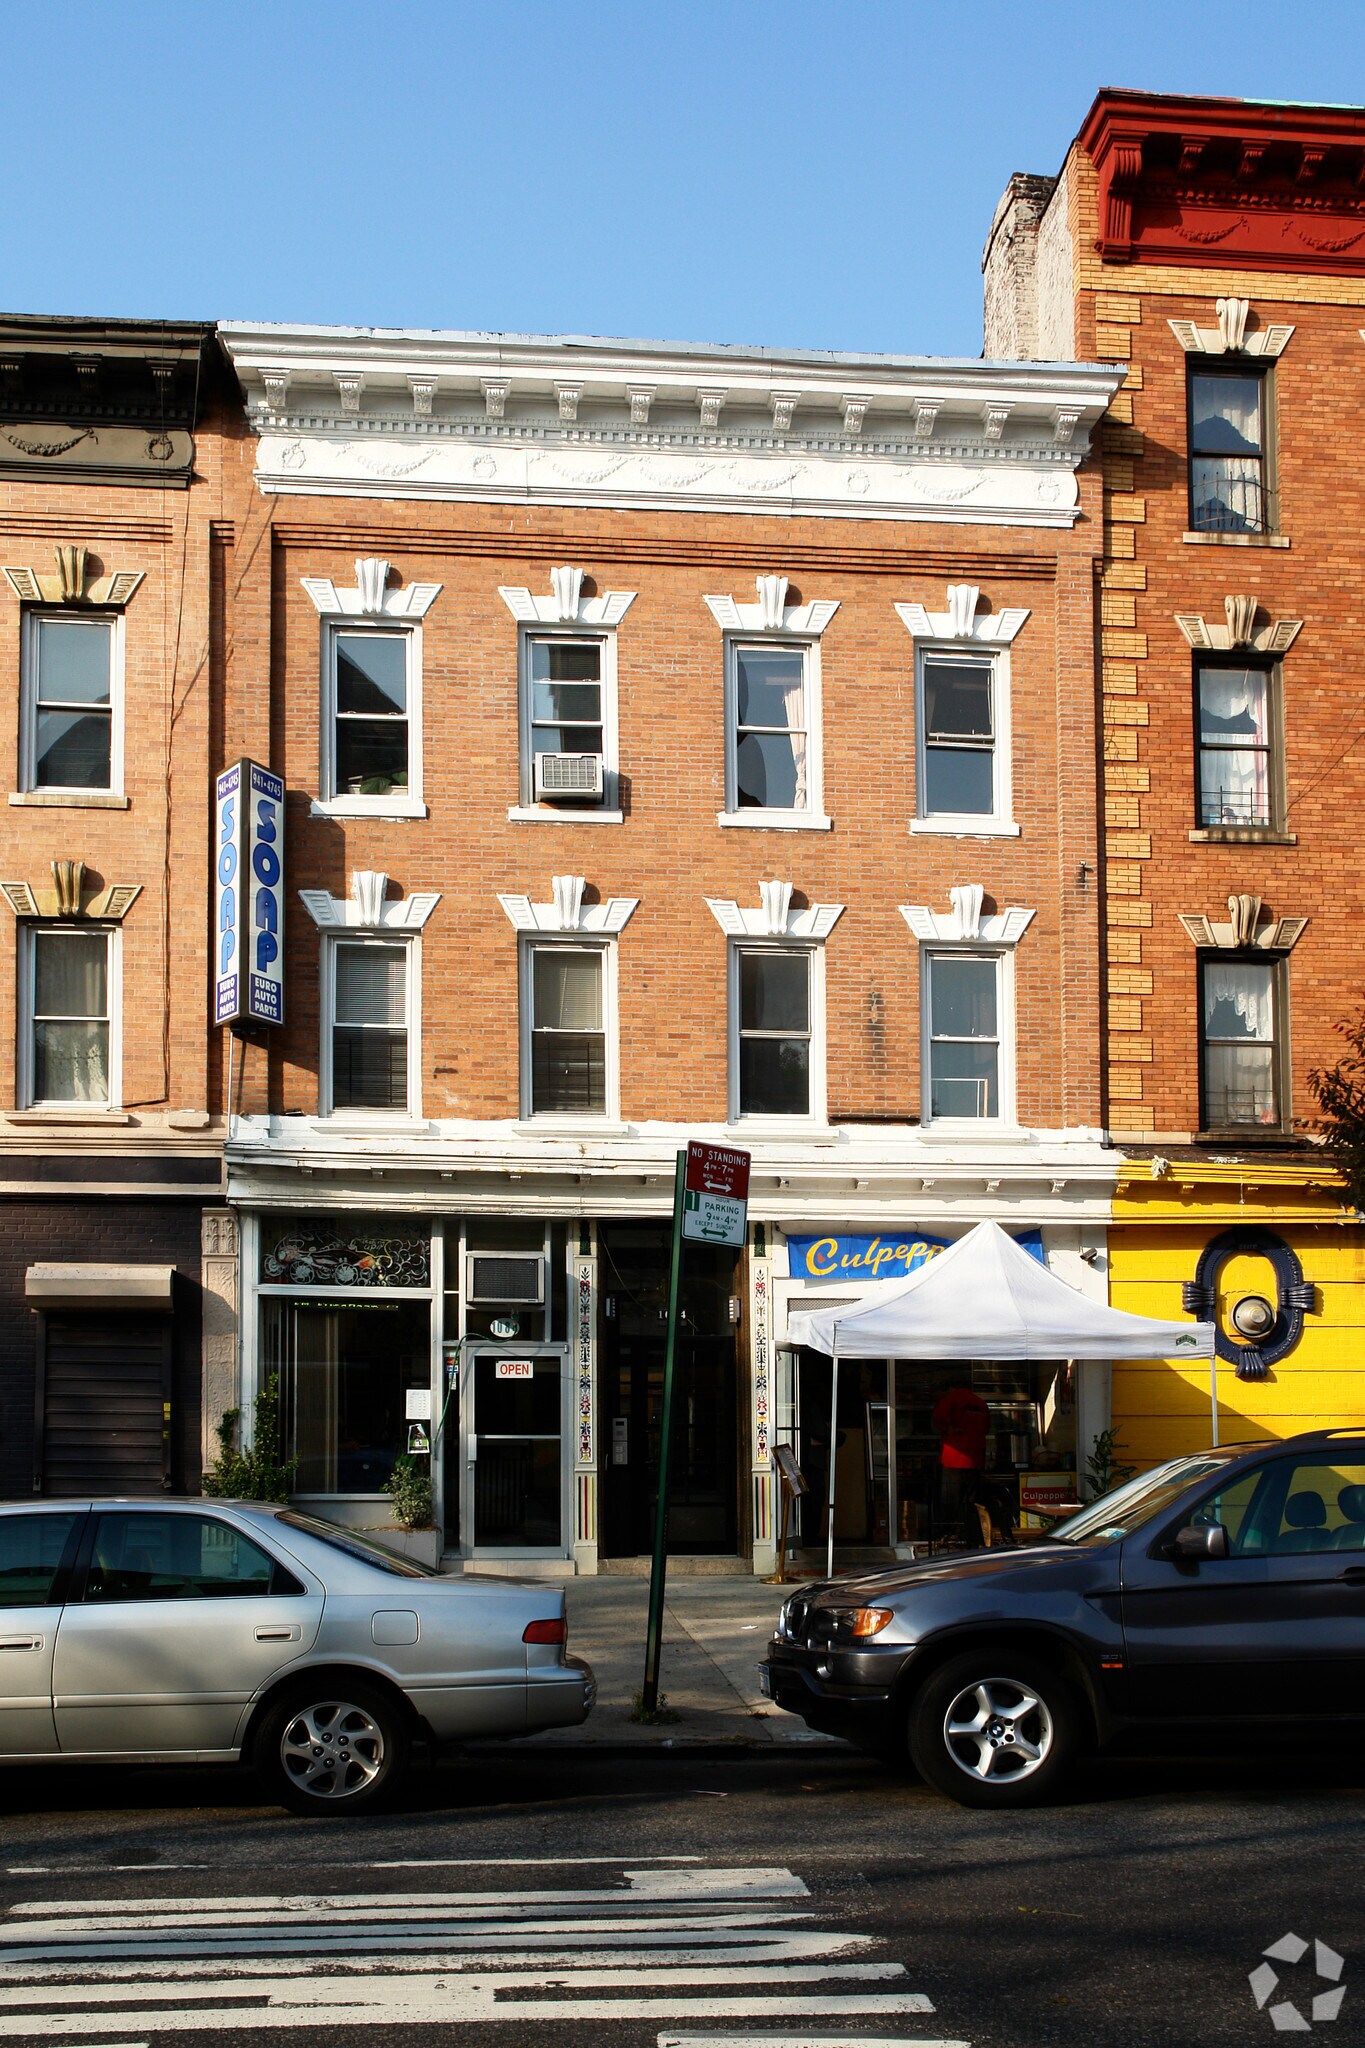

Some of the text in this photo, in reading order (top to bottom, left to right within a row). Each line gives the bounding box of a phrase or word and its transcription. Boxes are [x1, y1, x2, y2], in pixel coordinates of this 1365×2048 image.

[218, 797, 237, 974] SOAP
[252, 799, 280, 973] SOAP
[219, 977, 235, 993] EURO
[254, 977, 277, 993] EURO
[219, 988, 235, 1005] AUTO
[254, 989, 277, 1005] AUTO
[219, 1001, 235, 1017] PARTS
[254, 1001, 278, 1018] PARTS
[691, 1147, 747, 1166] NO STANDING
[704, 1201, 740, 1216] PARKING
[694, 1219, 735, 1231] EXCEPT SUNDAY
[499, 1363, 530, 1376] OPEN
